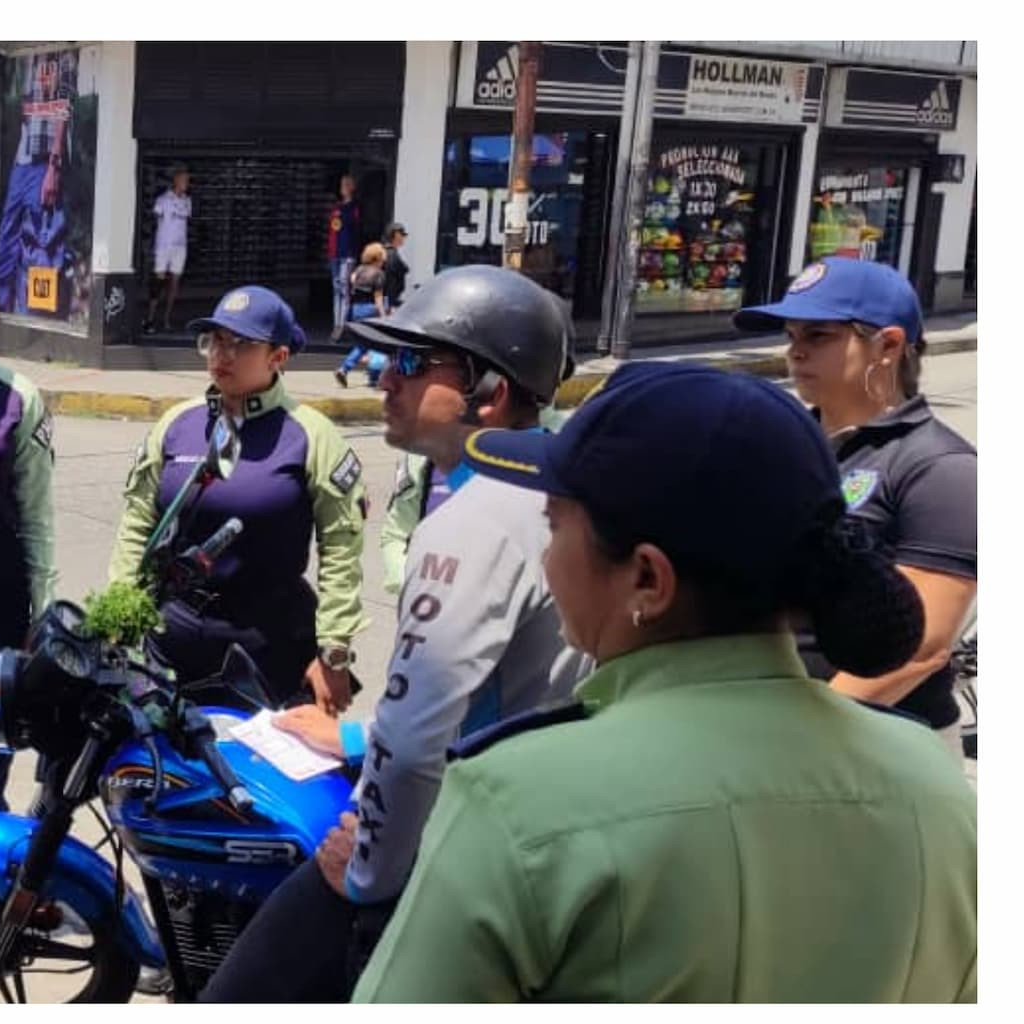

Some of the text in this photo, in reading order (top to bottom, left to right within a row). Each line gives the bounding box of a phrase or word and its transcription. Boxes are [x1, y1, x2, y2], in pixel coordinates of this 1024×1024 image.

[693, 59, 783, 86] HOLLMAN
[478, 81, 516, 99] adid
[915, 109, 953, 125] adidas
